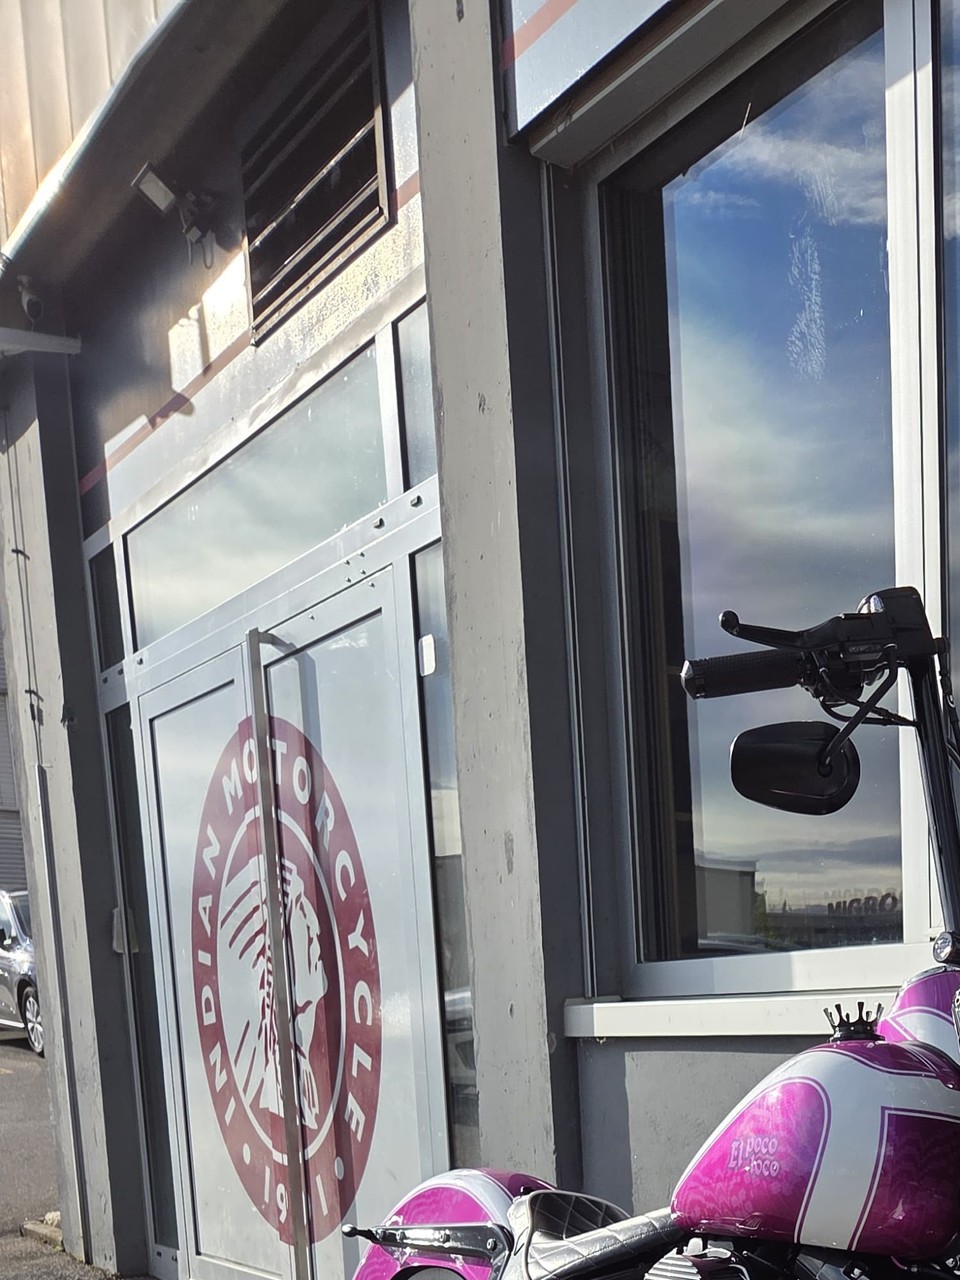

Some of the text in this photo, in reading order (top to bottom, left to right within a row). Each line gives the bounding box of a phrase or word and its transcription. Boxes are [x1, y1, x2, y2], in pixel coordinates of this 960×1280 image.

[198, 738, 373, 1142] INDIAN MOTORCYCLE
[264, 1165, 328, 1224] 191
